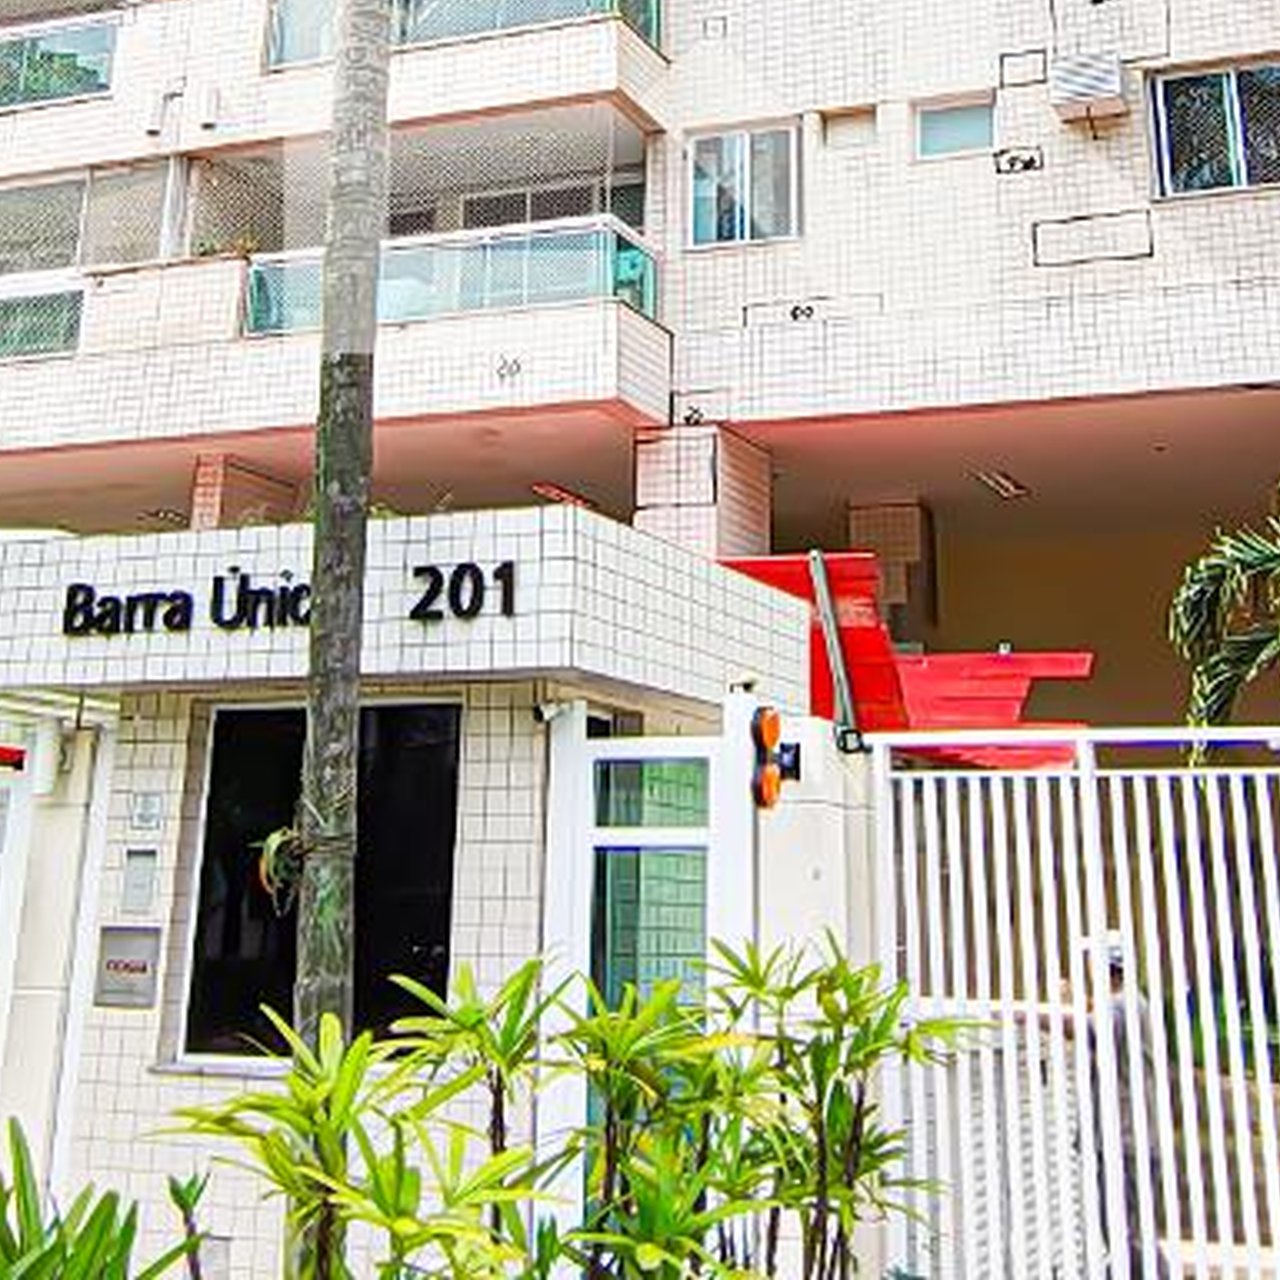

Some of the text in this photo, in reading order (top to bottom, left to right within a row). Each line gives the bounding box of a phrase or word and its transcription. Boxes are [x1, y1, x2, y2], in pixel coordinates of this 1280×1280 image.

[63, 560, 514, 635] Barra Únic 201
